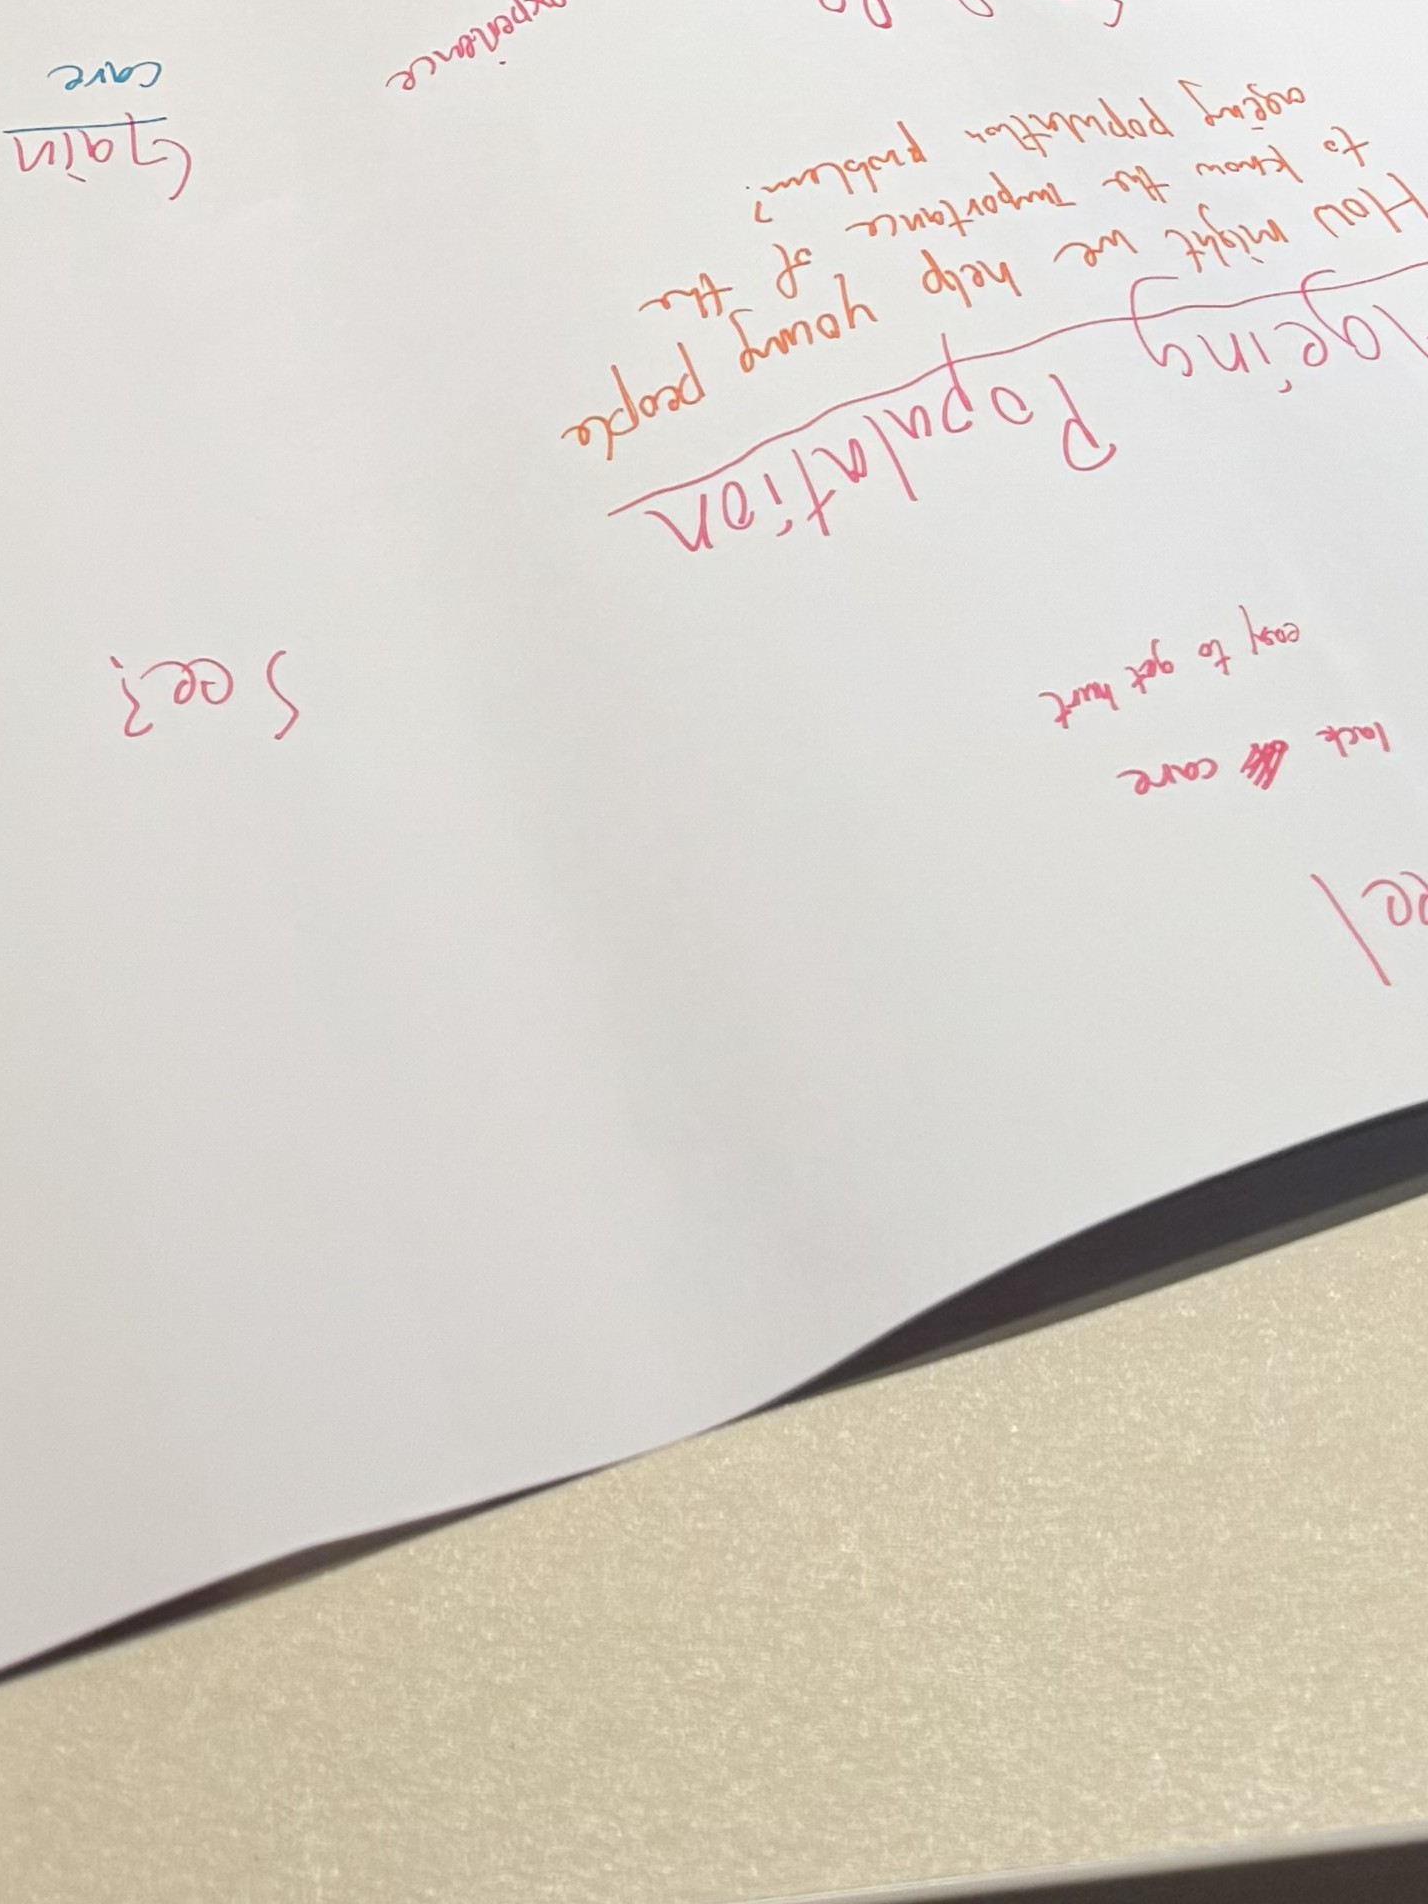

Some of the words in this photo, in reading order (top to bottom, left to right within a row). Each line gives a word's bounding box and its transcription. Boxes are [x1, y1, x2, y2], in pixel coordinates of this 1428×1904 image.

[45, 60, 164, 96] care
[963, 95, 1176, 147] population
[1322, 124, 1371, 162] to
[10, 111, 193, 202] Gain
[741, 120, 930, 226] problem?
[1100, 159, 1169, 205] the
[1193, 150, 1303, 184] know
[1051, 224, 1138, 274] we
[1164, 202, 1289, 271] might
[772, 240, 814, 298] of
[920, 238, 1024, 300] help
[637, 273, 734, 320] the
[736, 273, 879, 377] young
[561, 363, 707, 463] people
[643, 333, 1118, 556] Population
[1123, 637, 1177, 694] get
[1197, 638, 1232, 677] to
[109, 649, 301, 742] See?
[1037, 681, 1122, 731] hurt
[1315, 721, 1392, 759] lack
[1114, 757, 1222, 798] care
